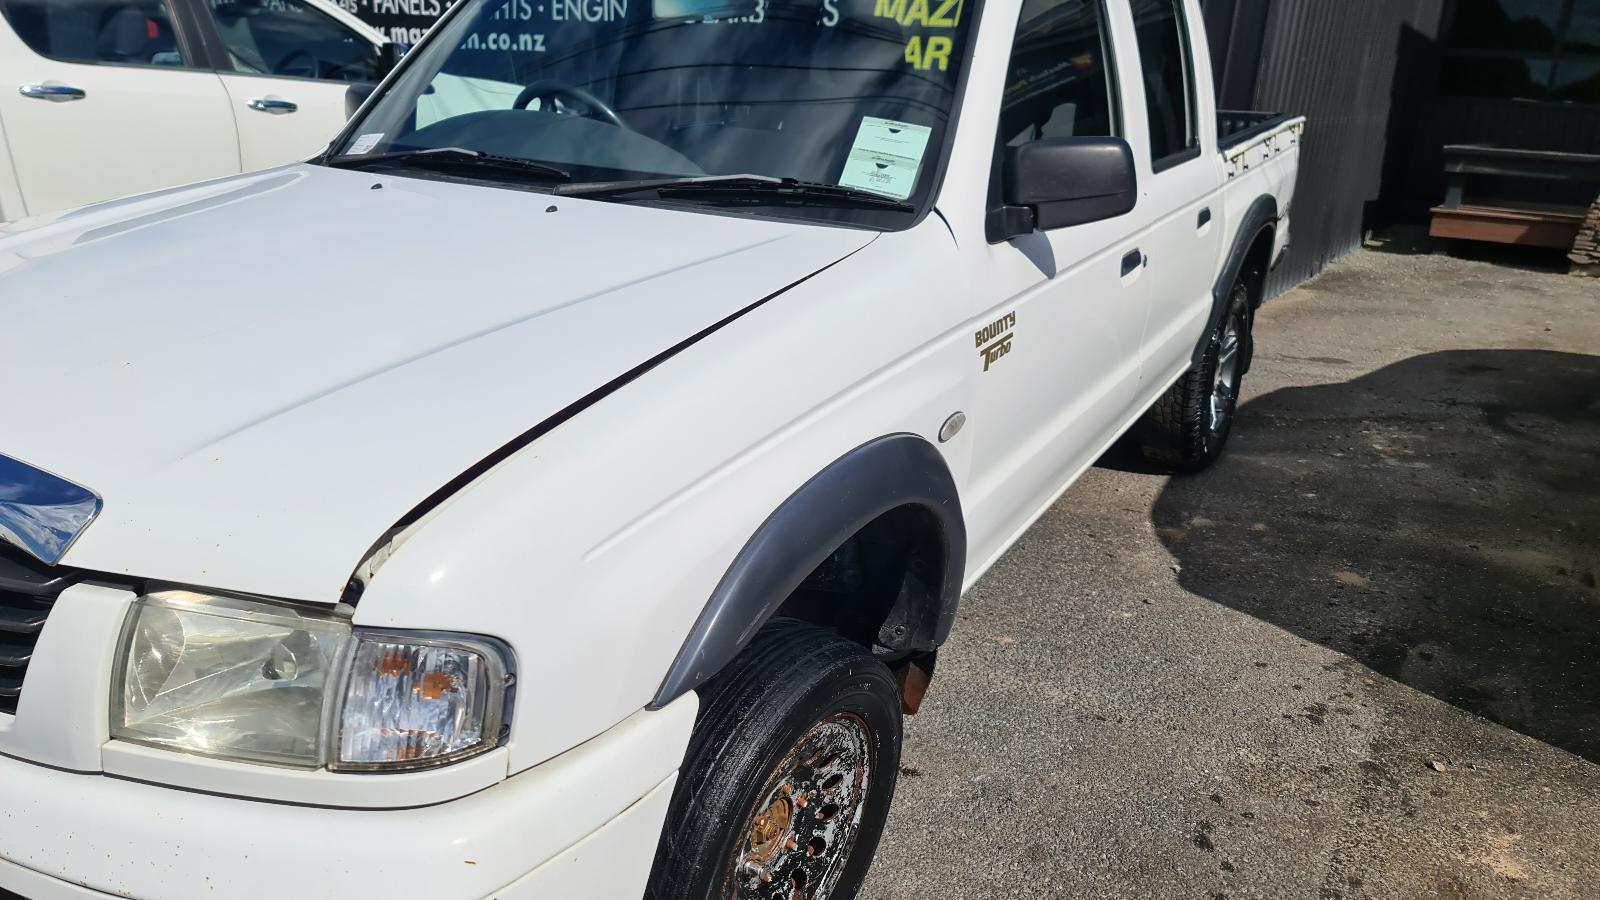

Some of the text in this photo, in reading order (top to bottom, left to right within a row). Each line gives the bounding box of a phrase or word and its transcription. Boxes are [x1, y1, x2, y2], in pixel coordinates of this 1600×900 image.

[374, 0, 441, 16] PANELS
[874, 0, 964, 27] MAZ
[975, 310, 1016, 348] BOUNTY
[980, 331, 1014, 372] Turbo
